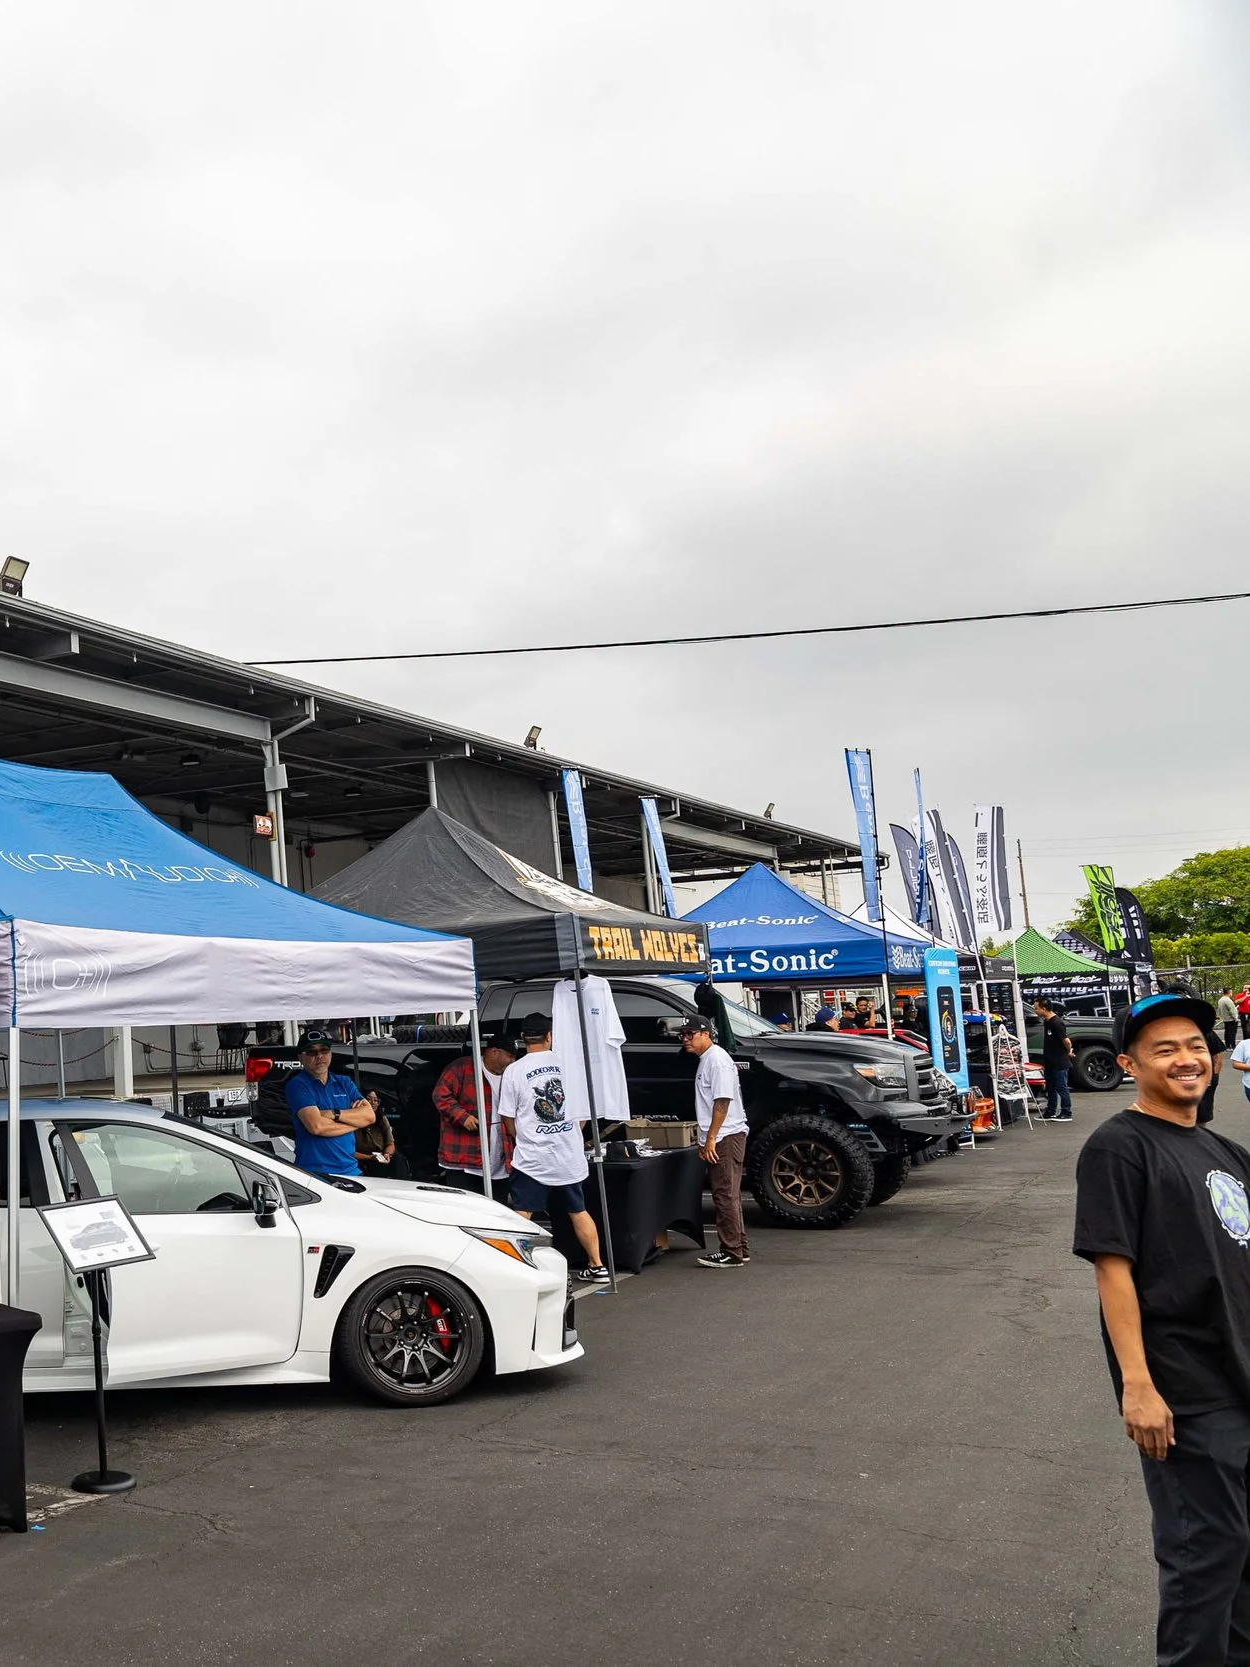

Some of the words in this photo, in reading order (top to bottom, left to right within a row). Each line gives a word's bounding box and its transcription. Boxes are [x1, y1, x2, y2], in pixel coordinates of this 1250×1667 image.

[588, 926, 641, 961] TRAIL
[639, 929, 699, 963] WOLVES
[536, 1122, 573, 1134] RAYS
